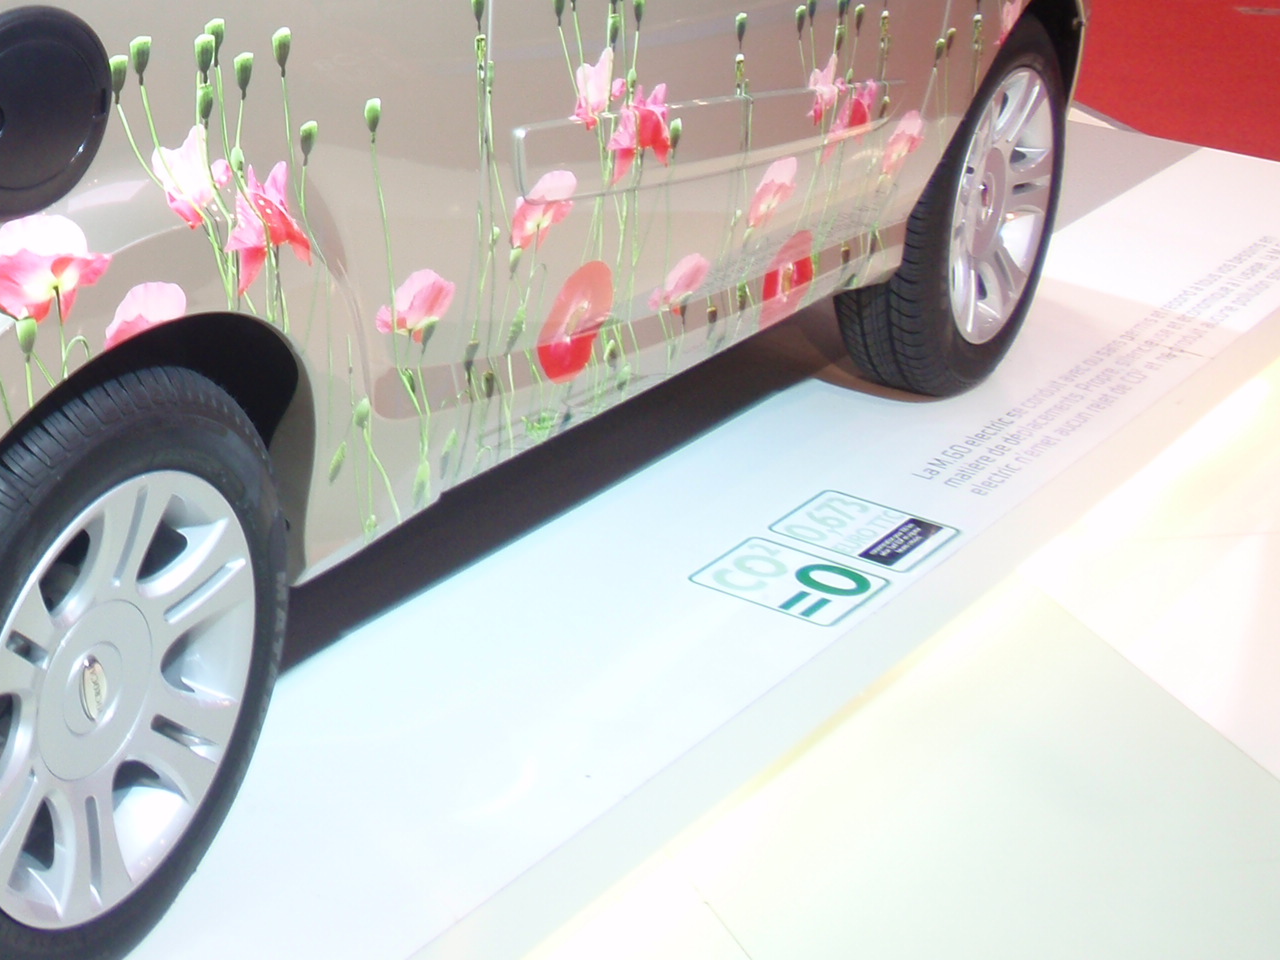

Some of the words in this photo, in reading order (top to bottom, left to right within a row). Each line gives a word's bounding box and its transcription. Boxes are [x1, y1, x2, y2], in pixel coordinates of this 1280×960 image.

[926, 443, 972, 469] M.GO
[964, 417, 1014, 447] electric
[943, 454, 996, 488] matière
[986, 443, 1011, 456] de
[970, 463, 1022, 496] electric
[1053, 411, 1093, 436] aucun
